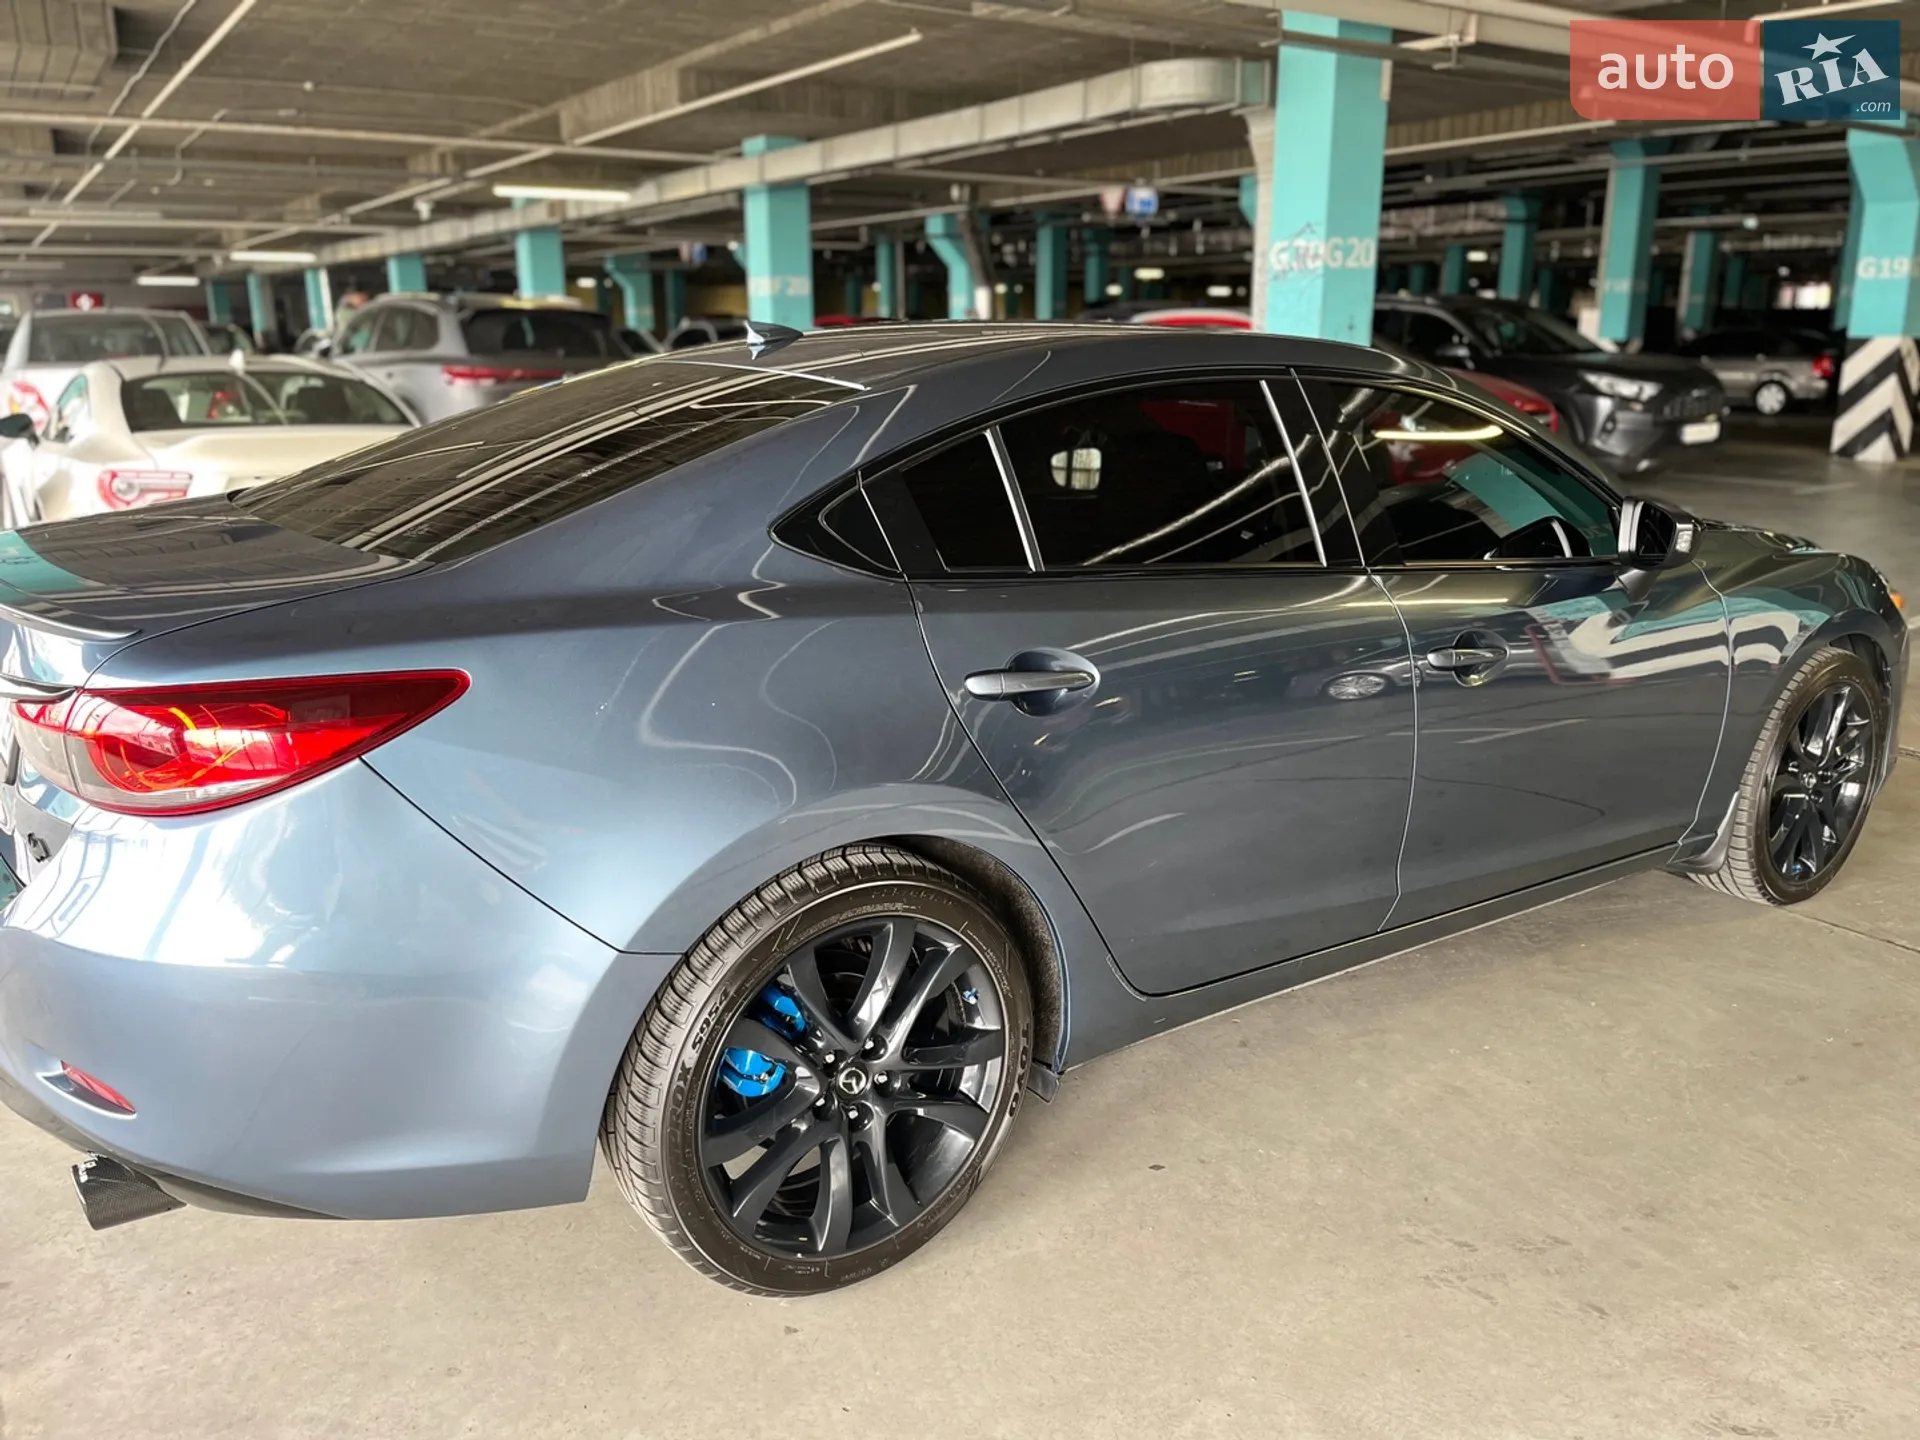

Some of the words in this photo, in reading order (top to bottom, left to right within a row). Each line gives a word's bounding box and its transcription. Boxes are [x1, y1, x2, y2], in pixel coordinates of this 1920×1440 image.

[1325, 236, 1376, 269] G20
[1858, 256, 1909, 279] G19
[691, 986, 730, 1054] S954
[1008, 1022, 1031, 1118] TOYO
